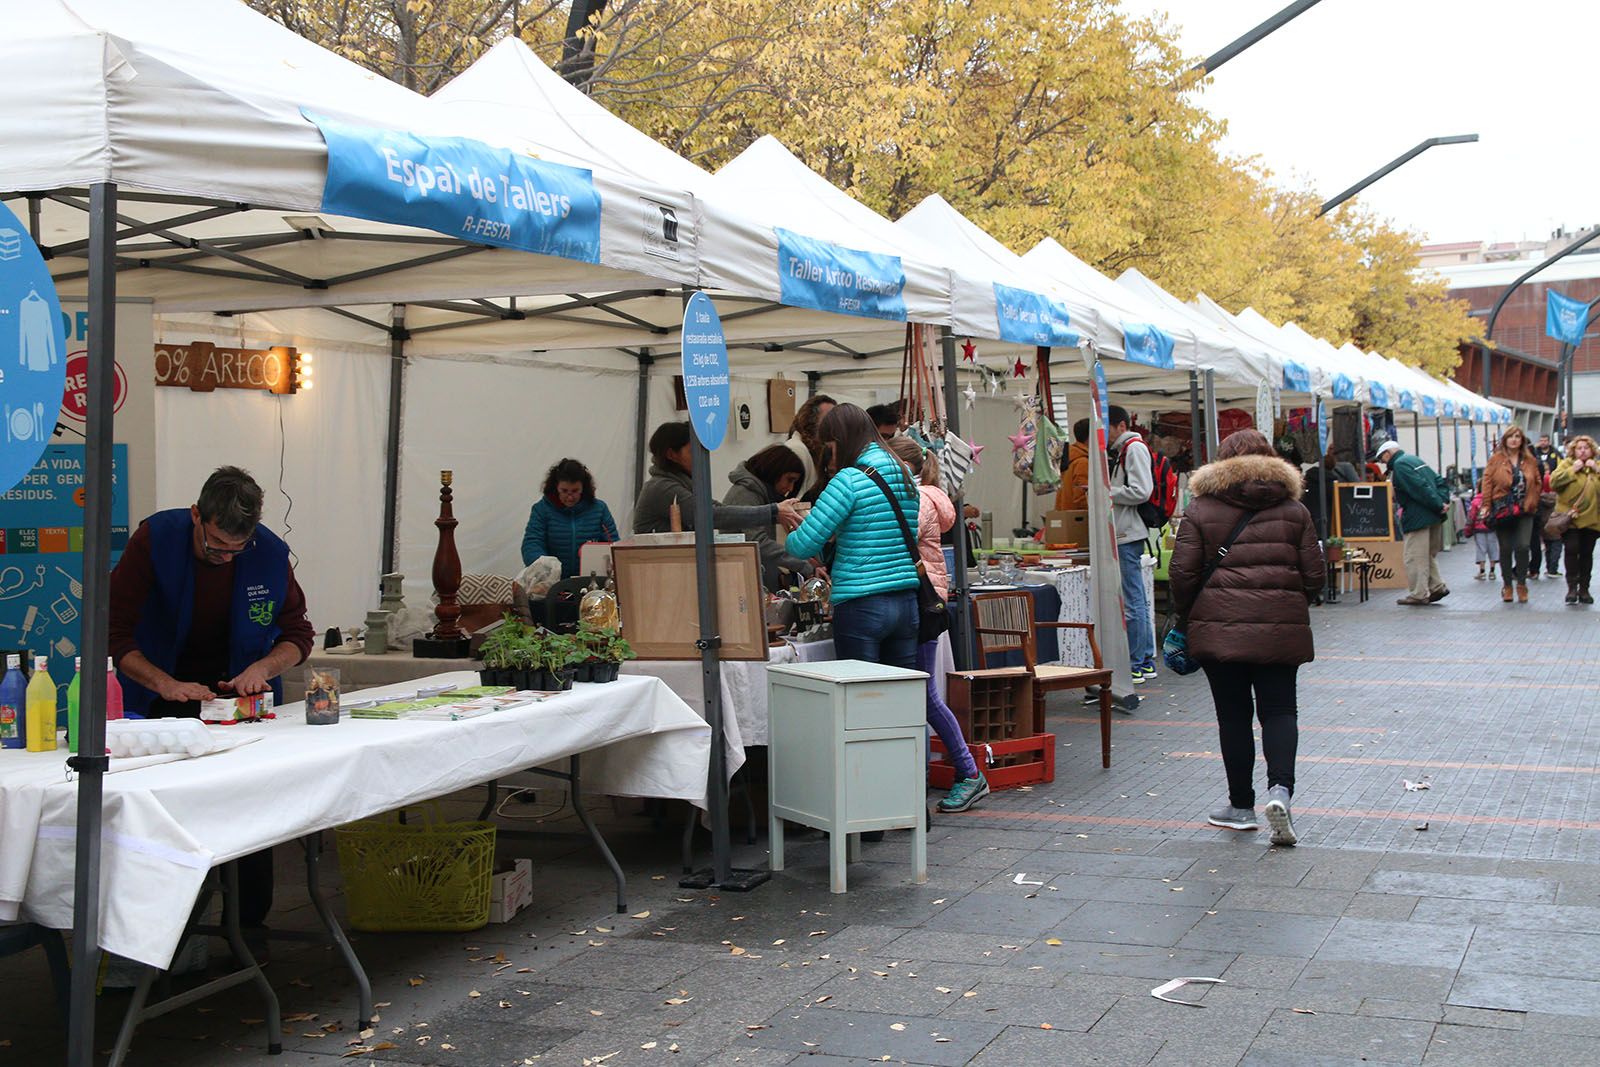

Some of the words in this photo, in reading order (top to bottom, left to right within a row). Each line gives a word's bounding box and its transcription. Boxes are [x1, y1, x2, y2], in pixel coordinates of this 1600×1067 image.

[383, 147, 461, 197] Espai
[467, 166, 497, 203] de
[499, 175, 571, 218] Tallers
[462, 215, 512, 240] R-FESTA
[789, 256, 823, 283] Taller
[51, 459, 81, 470] VIDA
[23, 474, 49, 485] PER
